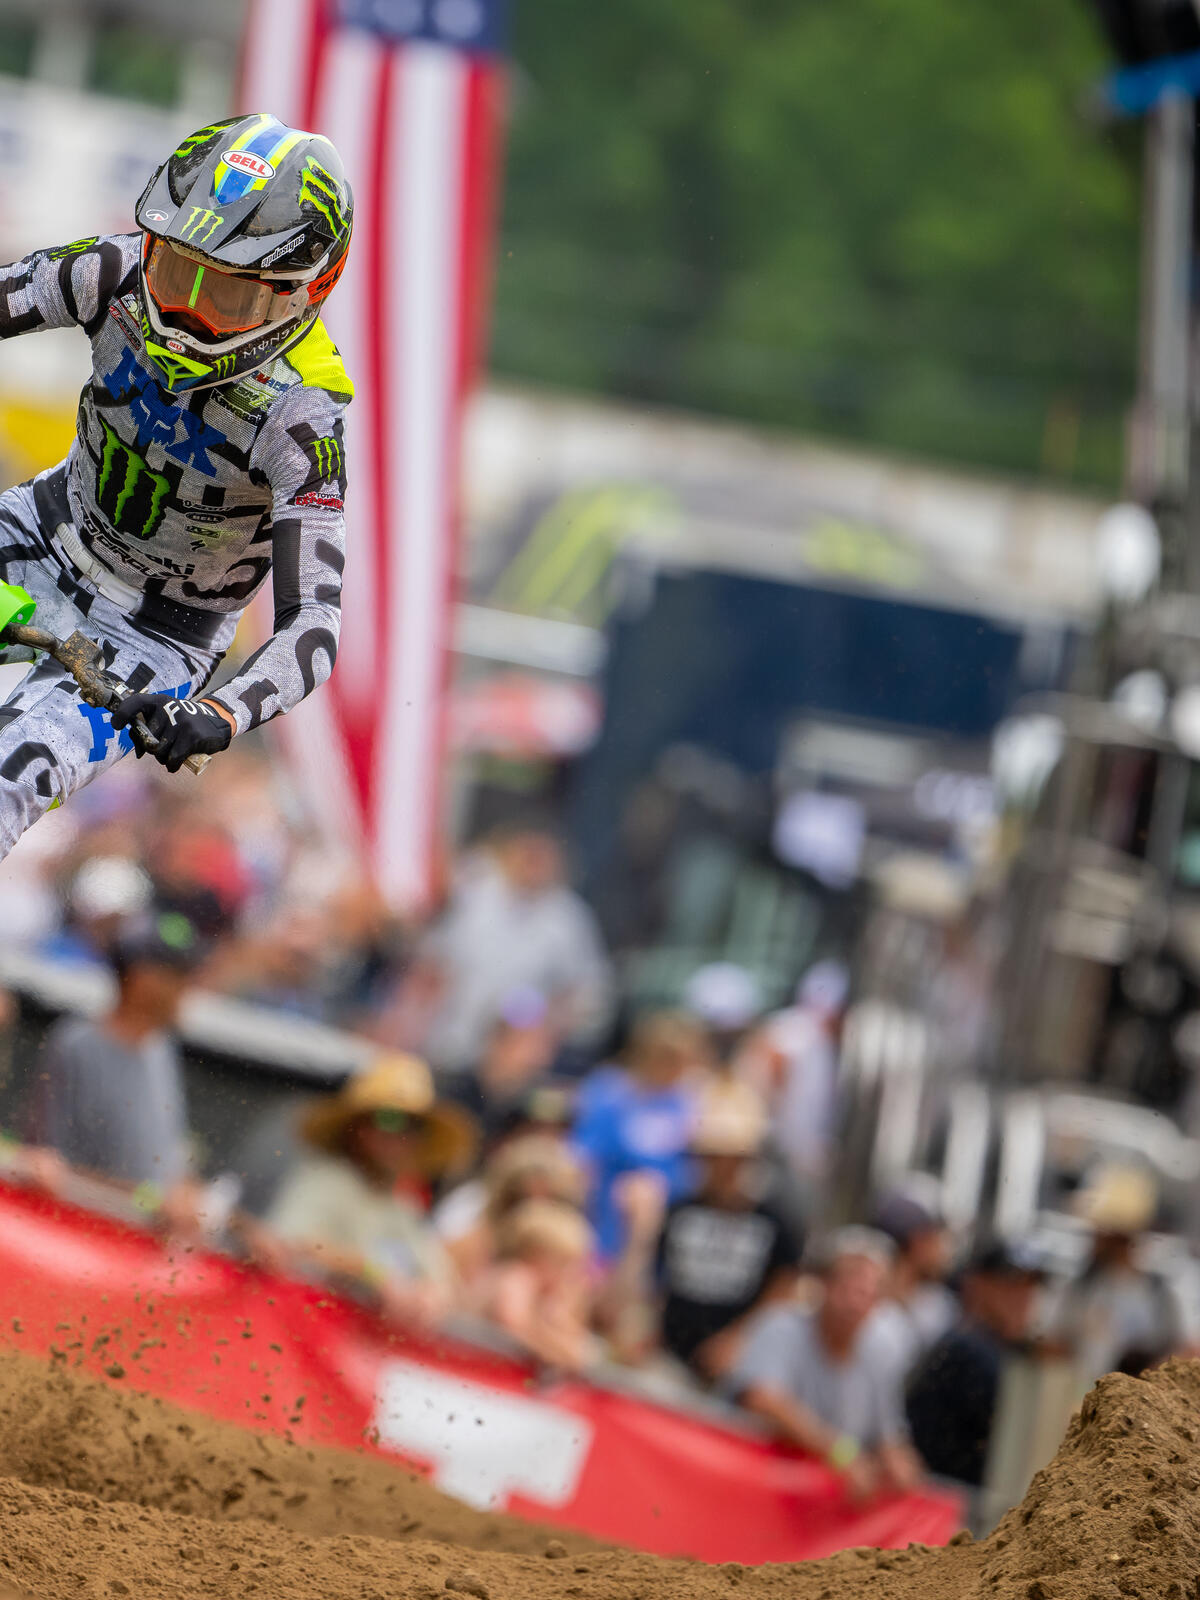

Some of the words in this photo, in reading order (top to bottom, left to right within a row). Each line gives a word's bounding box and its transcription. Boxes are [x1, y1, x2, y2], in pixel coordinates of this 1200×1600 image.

[228, 153, 266, 176] BELL
[261, 234, 306, 268] apdesigns
[168, 341, 183, 351] BELL
[163, 699, 218, 727] FOX
